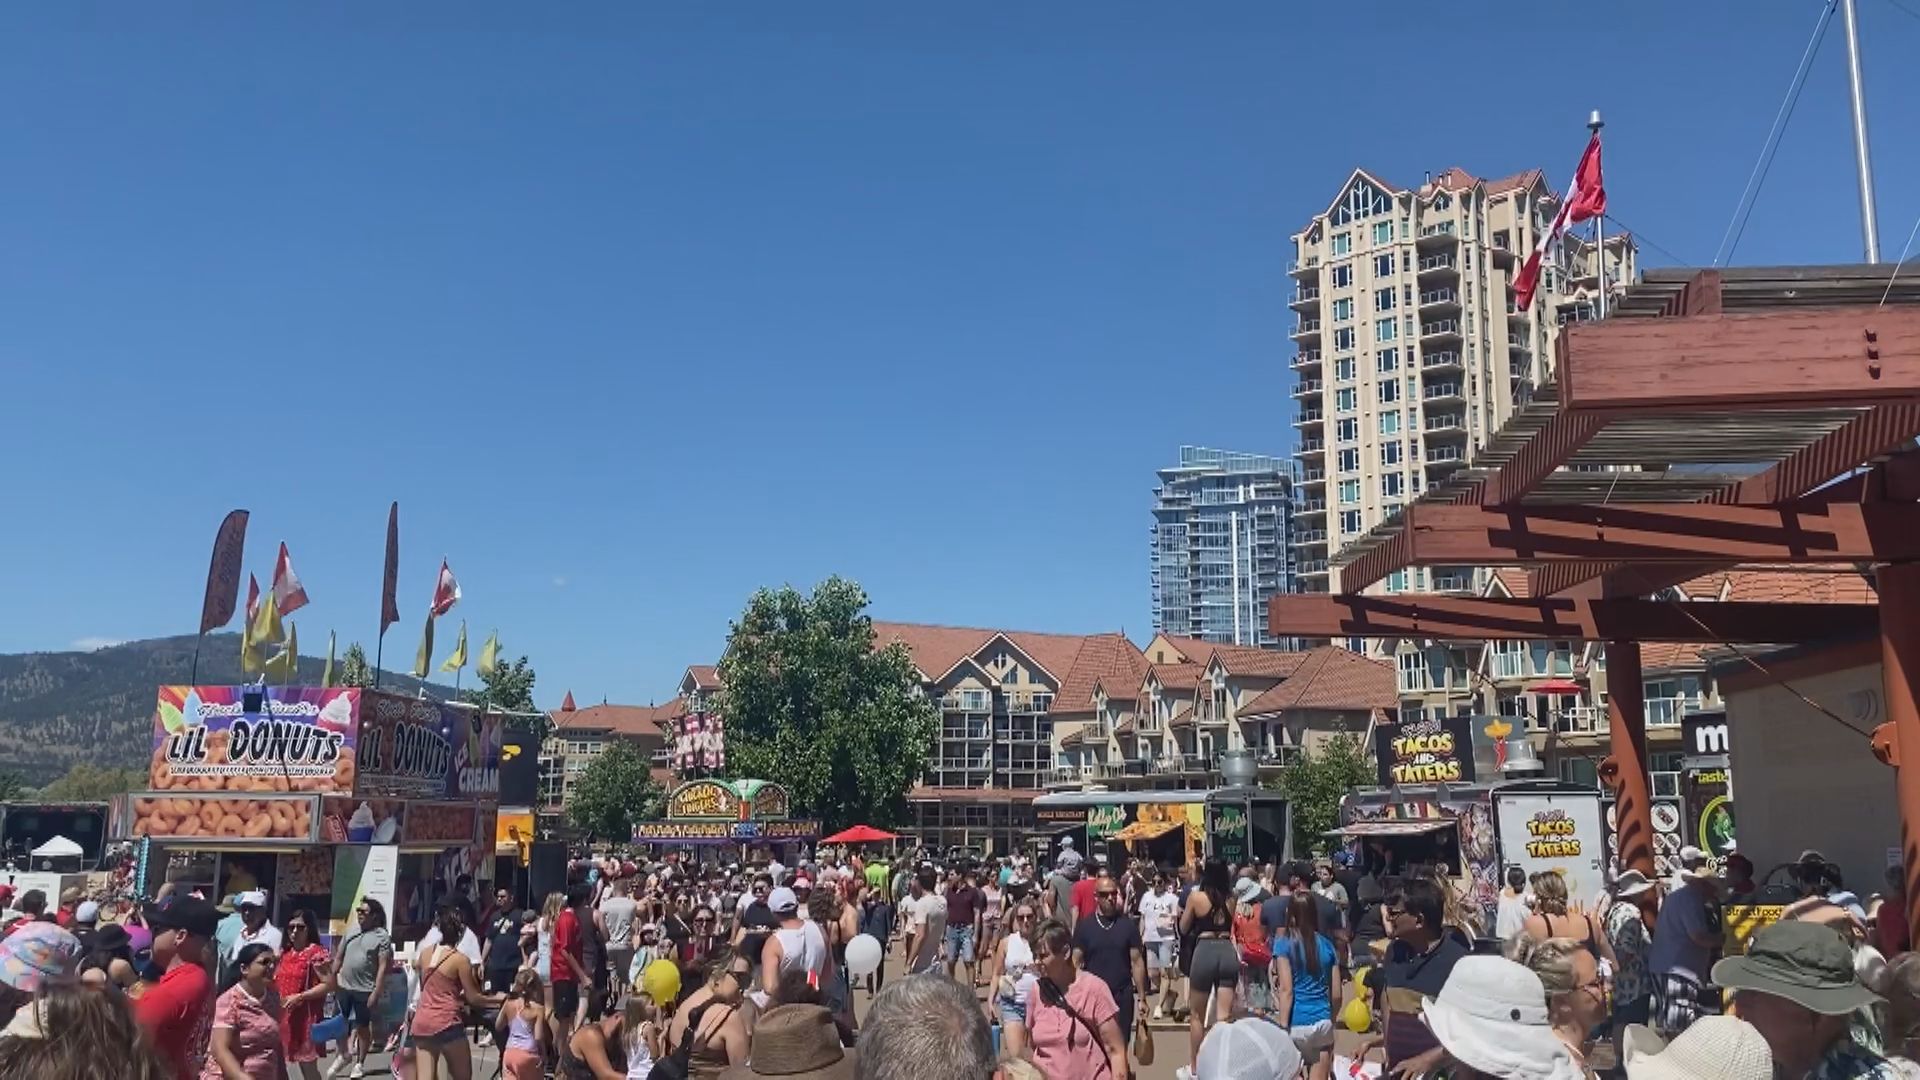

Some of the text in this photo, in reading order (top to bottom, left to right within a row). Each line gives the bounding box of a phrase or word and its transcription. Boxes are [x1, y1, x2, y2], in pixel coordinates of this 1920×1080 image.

[166, 719, 344, 764] LIL DONUTS
[391, 721, 452, 778] DONUTS
[1392, 732, 1454, 757] TACOS
[458, 767, 500, 793] CREAM
[1391, 760, 1460, 783] TATERS
[1526, 819, 1576, 837] TACOS
[1525, 839, 1582, 858] TATERS
